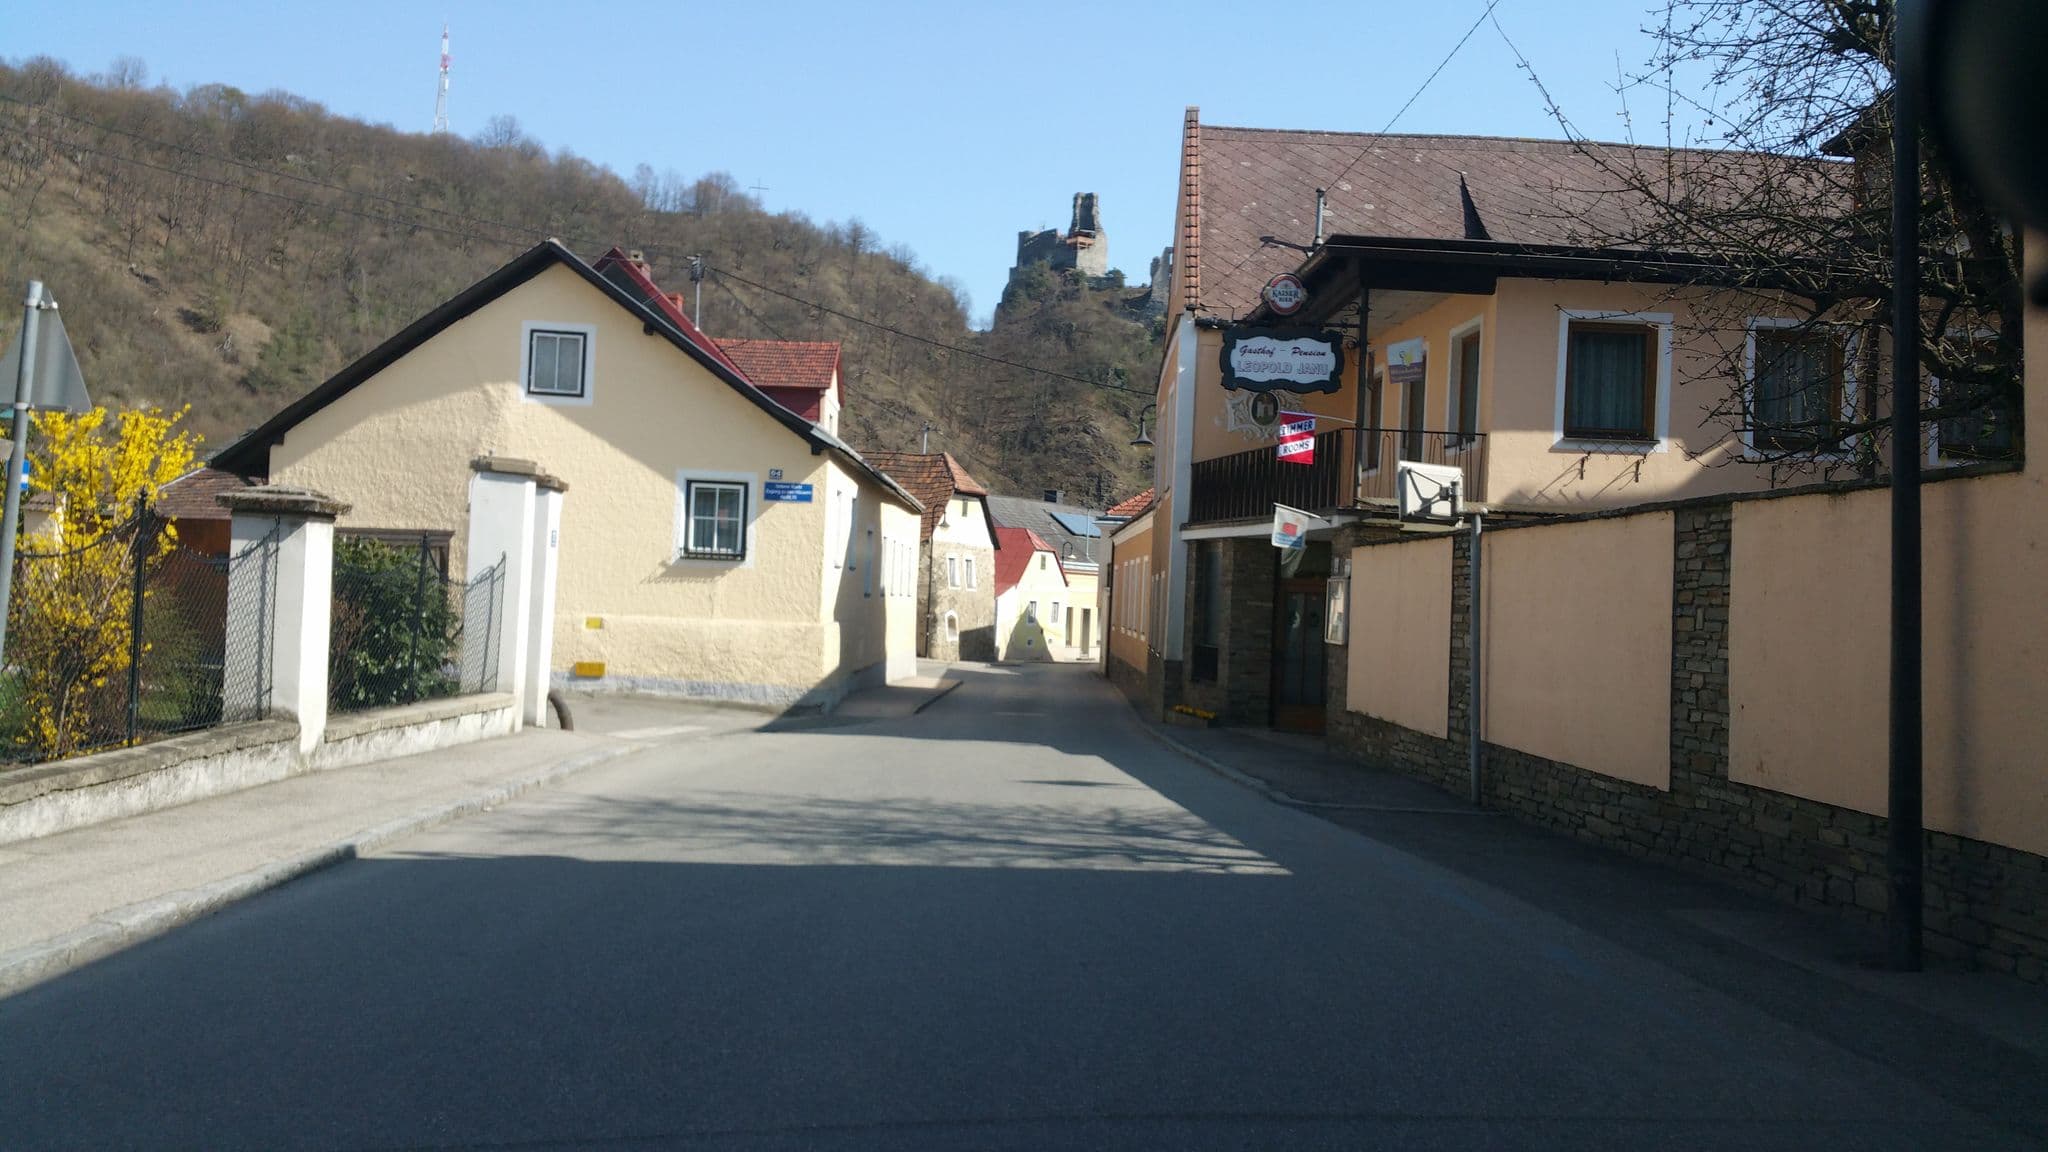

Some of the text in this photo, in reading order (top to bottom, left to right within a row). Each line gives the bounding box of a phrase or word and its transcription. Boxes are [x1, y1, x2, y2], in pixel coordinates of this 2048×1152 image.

[1272, 289, 1299, 299] KAISER
[1239, 344, 1276, 358] Gasthof
[1291, 346, 1327, 357] Pension
[1236, 360, 1293, 374] LEOPOLD
[1282, 440, 1310, 454] ROOMS
